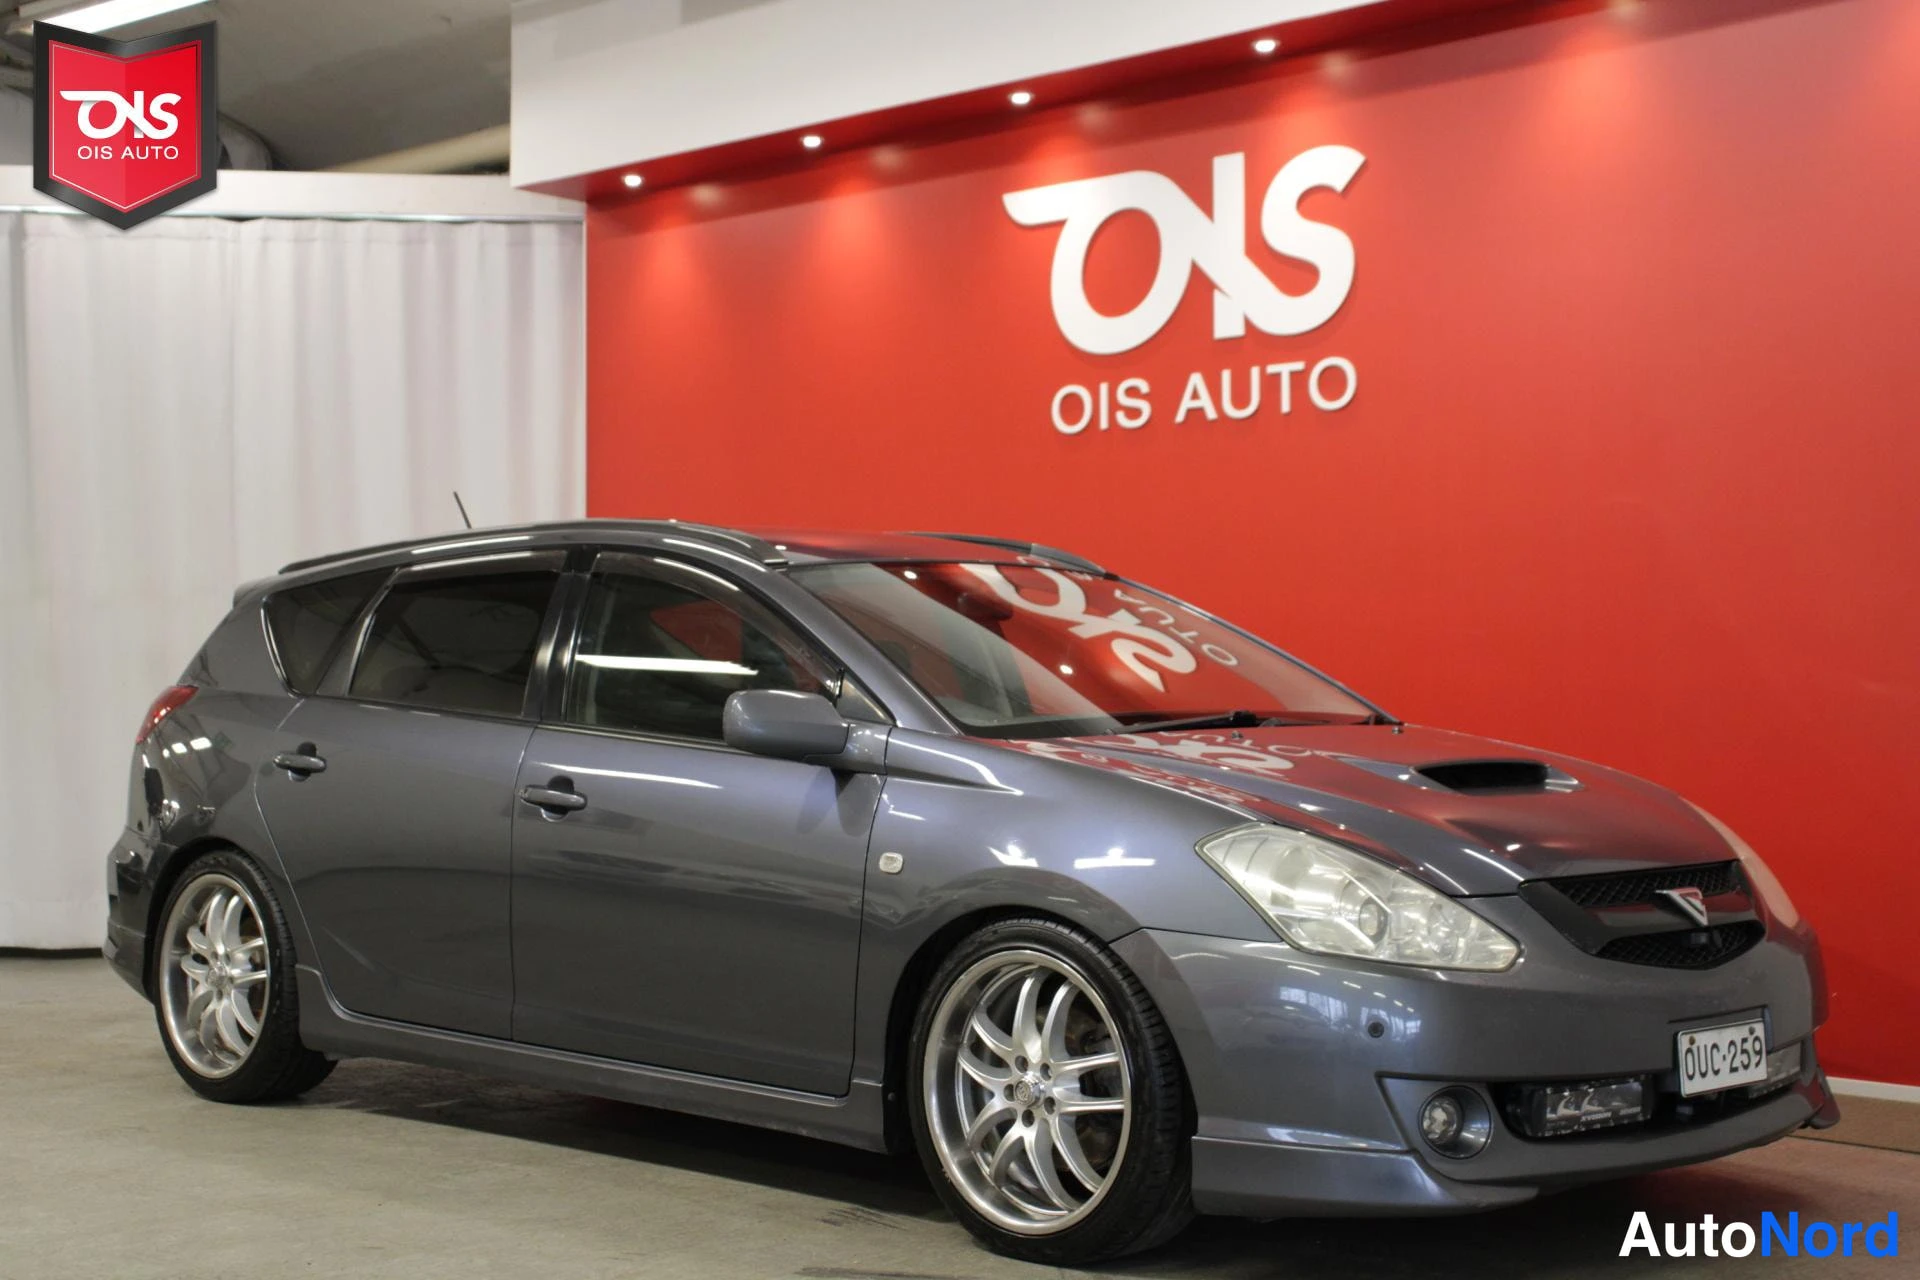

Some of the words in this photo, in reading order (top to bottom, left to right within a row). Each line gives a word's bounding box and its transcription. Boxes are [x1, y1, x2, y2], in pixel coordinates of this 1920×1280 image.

[1002, 145, 1367, 355] OIS
[1051, 378, 1152, 434] OIS
[1174, 356, 1357, 424] AUTO
[1684, 1035, 1763, 1081] OUC-259
